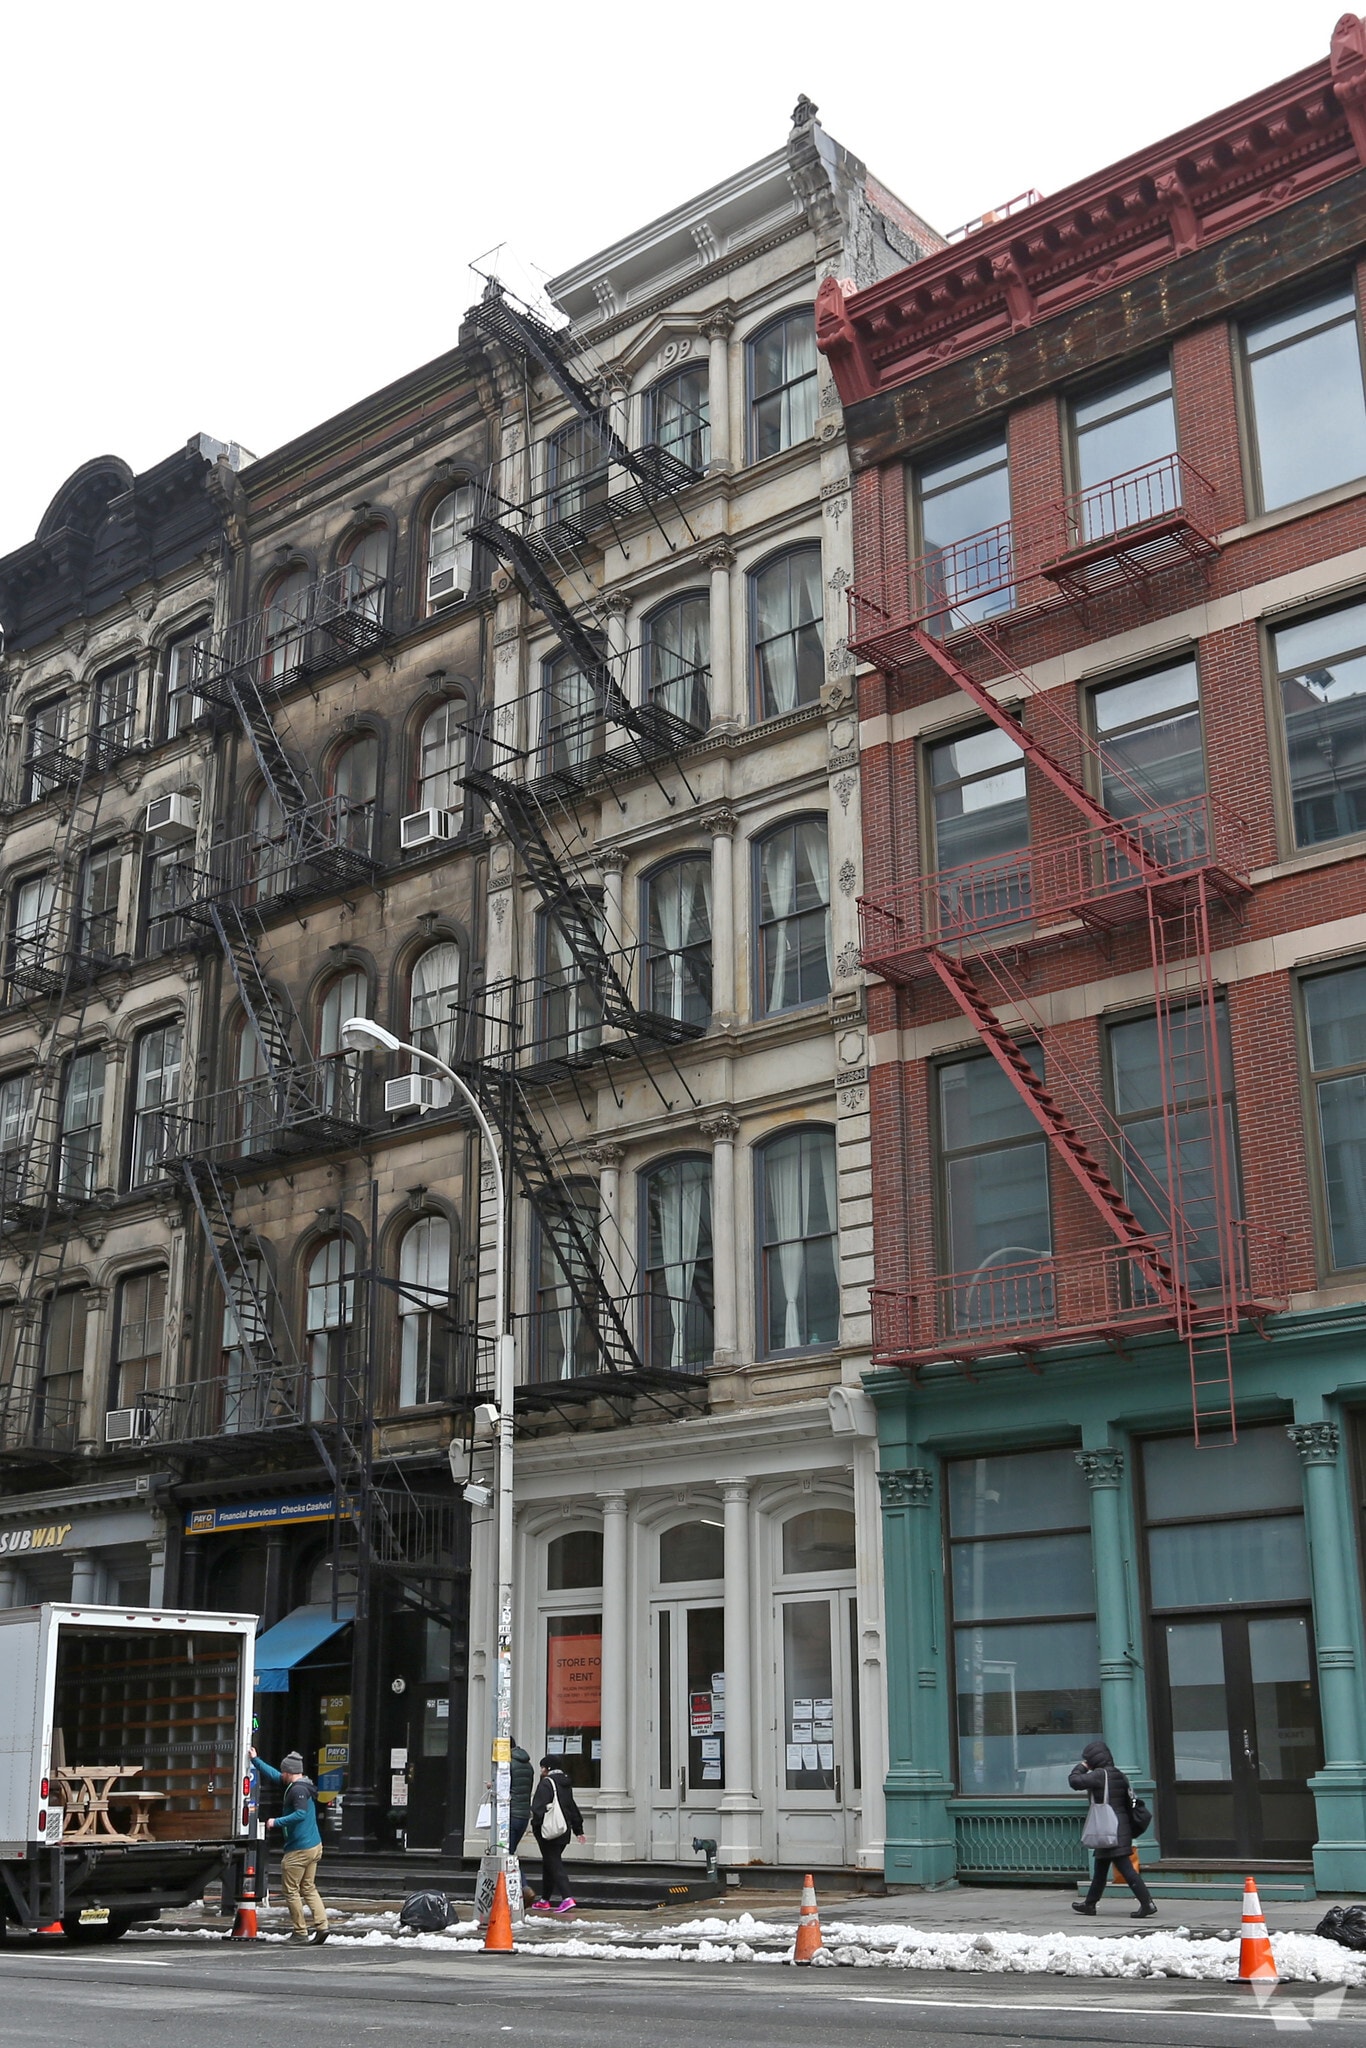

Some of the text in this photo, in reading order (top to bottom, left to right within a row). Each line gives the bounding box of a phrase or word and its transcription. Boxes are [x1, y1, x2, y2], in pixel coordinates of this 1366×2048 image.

[219, 1510, 247, 1521] Financial
[248, 1507, 277, 1518] Services
[280, 1503, 305, 1515] Checks
[194, 1521, 213, 1529] MATIC
[0, 1523, 72, 1553] SUBWAY
[556, 1656, 602, 1668] STORE FO
[570, 1672, 594, 1681] RENT
[330, 1698, 344, 1707] 295
